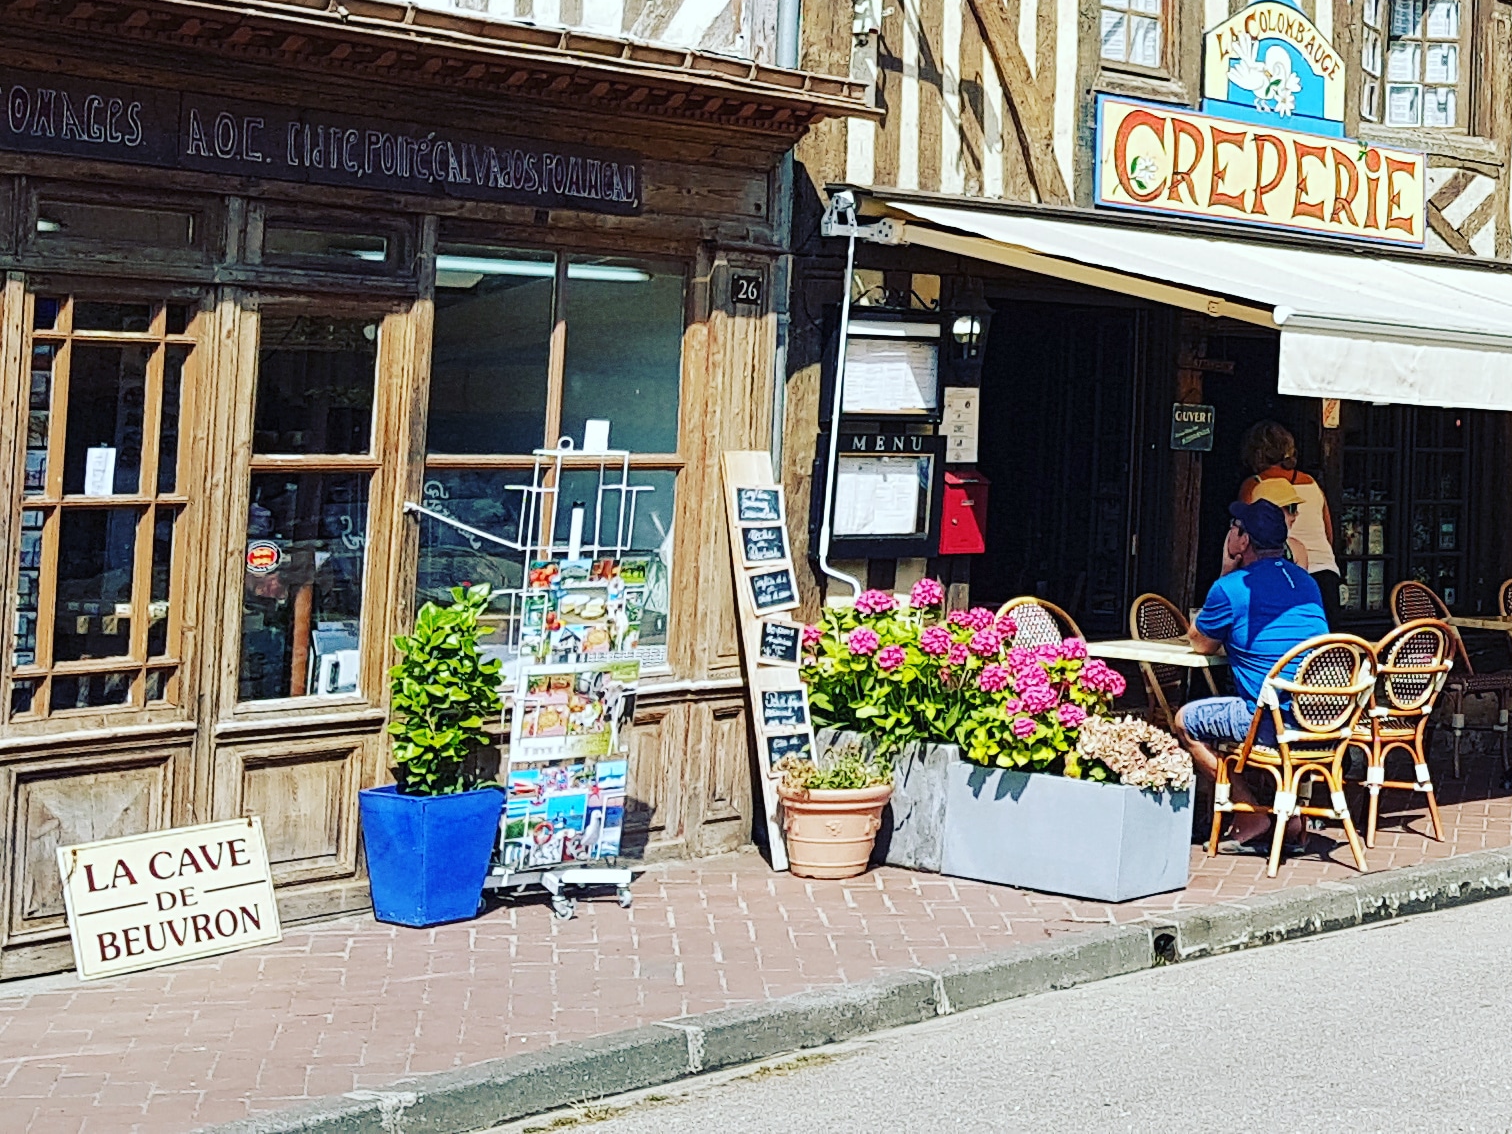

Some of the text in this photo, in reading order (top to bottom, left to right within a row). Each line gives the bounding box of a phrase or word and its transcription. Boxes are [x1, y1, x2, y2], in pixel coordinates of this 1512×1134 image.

[1216, 9, 1341, 83] LA COLOMB'AUGE
[1114, 109, 1417, 236] CREPERIE
[738, 280, 758, 300] 26
[1175, 411, 1212, 423] OUVERT
[852, 435, 923, 452] MENU
[83, 838, 251, 893] LA CAVE
[155, 886, 198, 912] DE
[97, 903, 262, 962] BEUVRON
